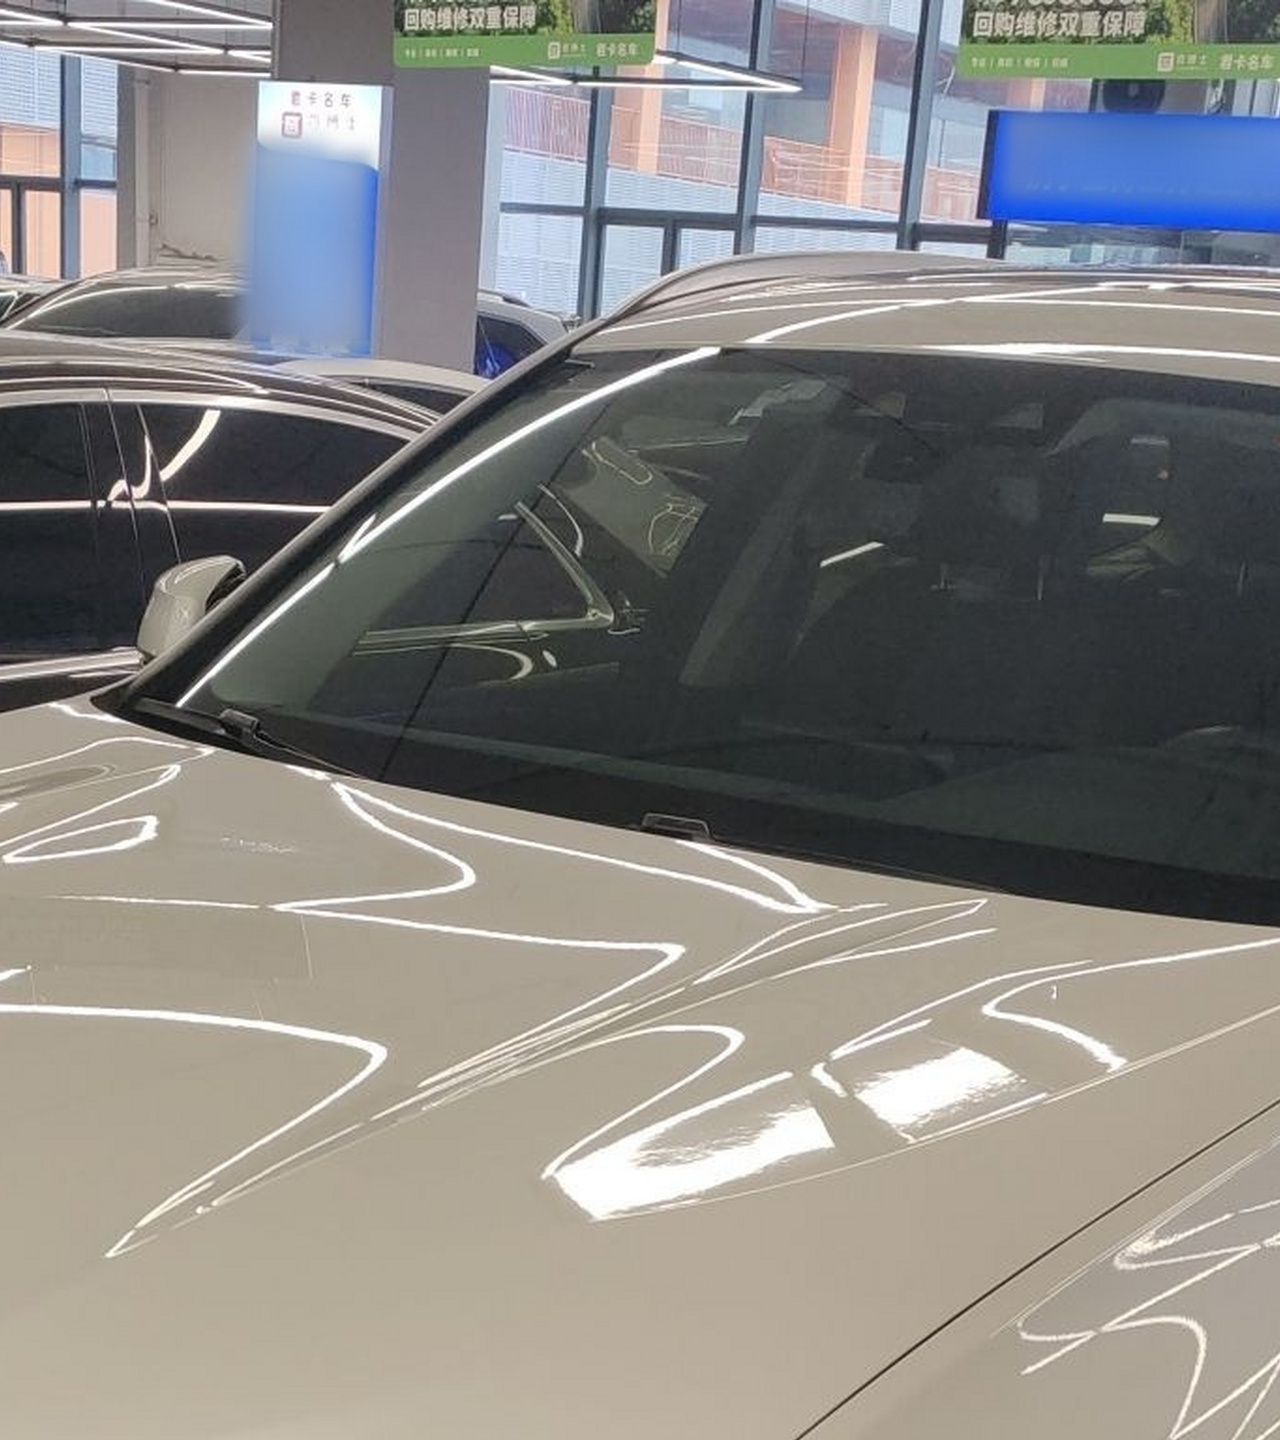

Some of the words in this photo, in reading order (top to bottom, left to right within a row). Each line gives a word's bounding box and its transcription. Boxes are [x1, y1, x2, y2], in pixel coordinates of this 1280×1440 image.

[404, 6, 537, 31] 回购维修双重保障
[973, 10, 1147, 38] 回购维修双重保障
